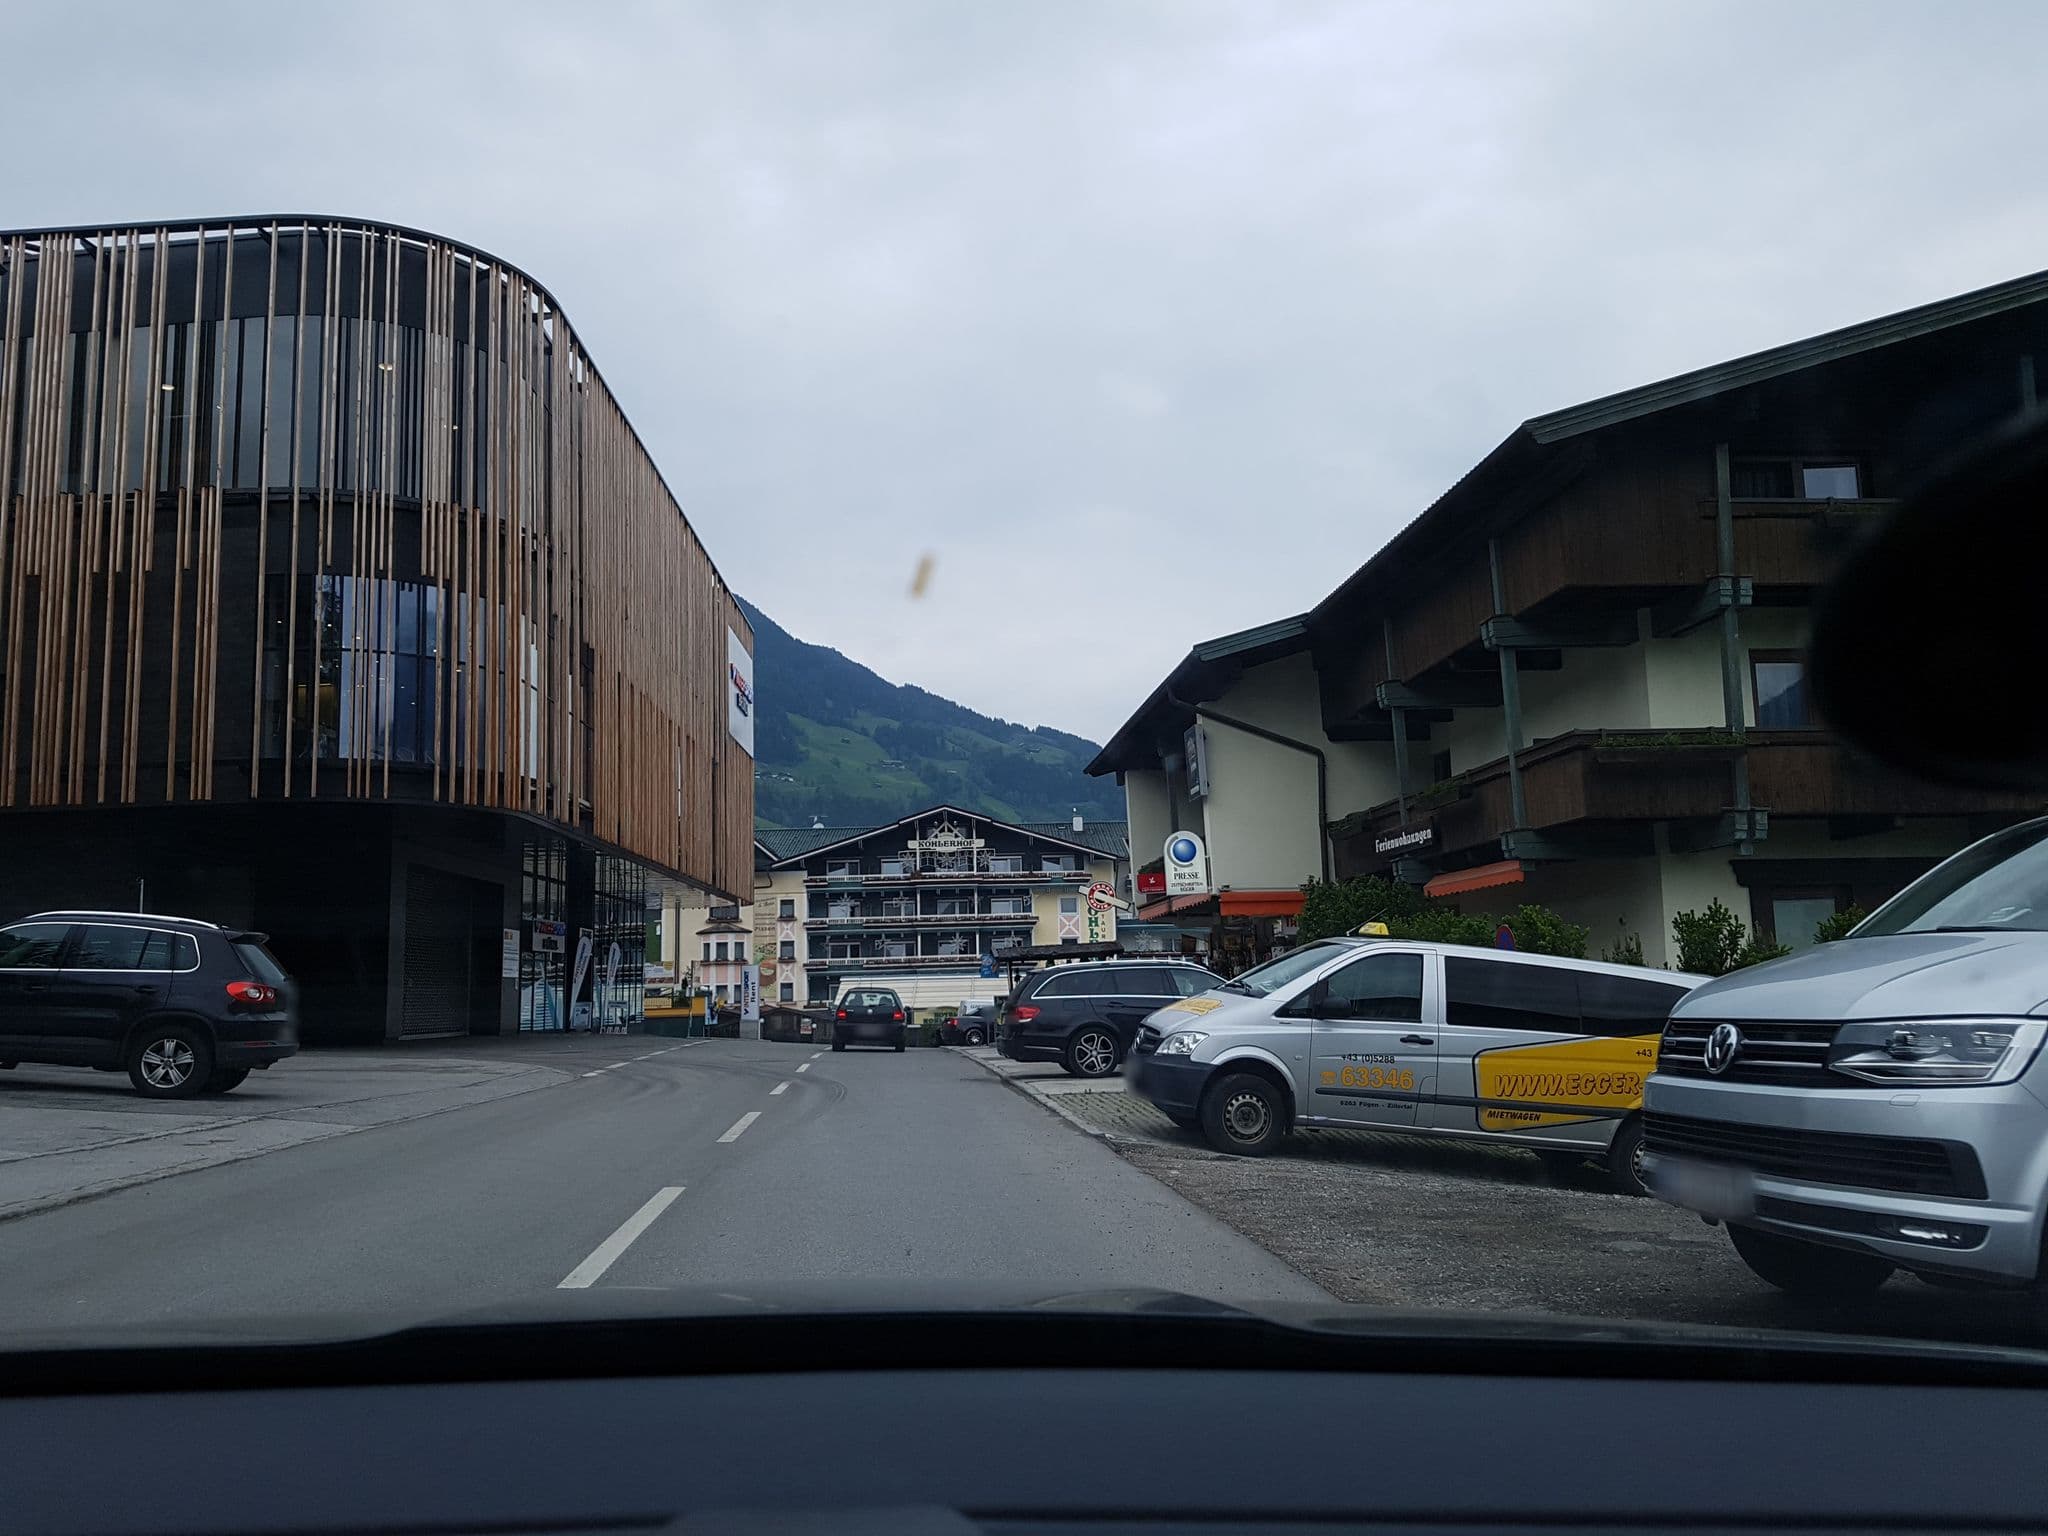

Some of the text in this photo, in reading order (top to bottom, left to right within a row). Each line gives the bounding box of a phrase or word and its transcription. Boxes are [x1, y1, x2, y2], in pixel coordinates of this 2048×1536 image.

[1173, 872, 1200, 880] PRESSE
[1635, 1048, 1653, 1058] +43
[1361, 1054, 1395, 1064] (0)5288
[1341, 1065, 1414, 1090] 63346
[1494, 1072, 1643, 1098] WWW.EGGER-
[1487, 1110, 1541, 1121] MIETWAGEN
